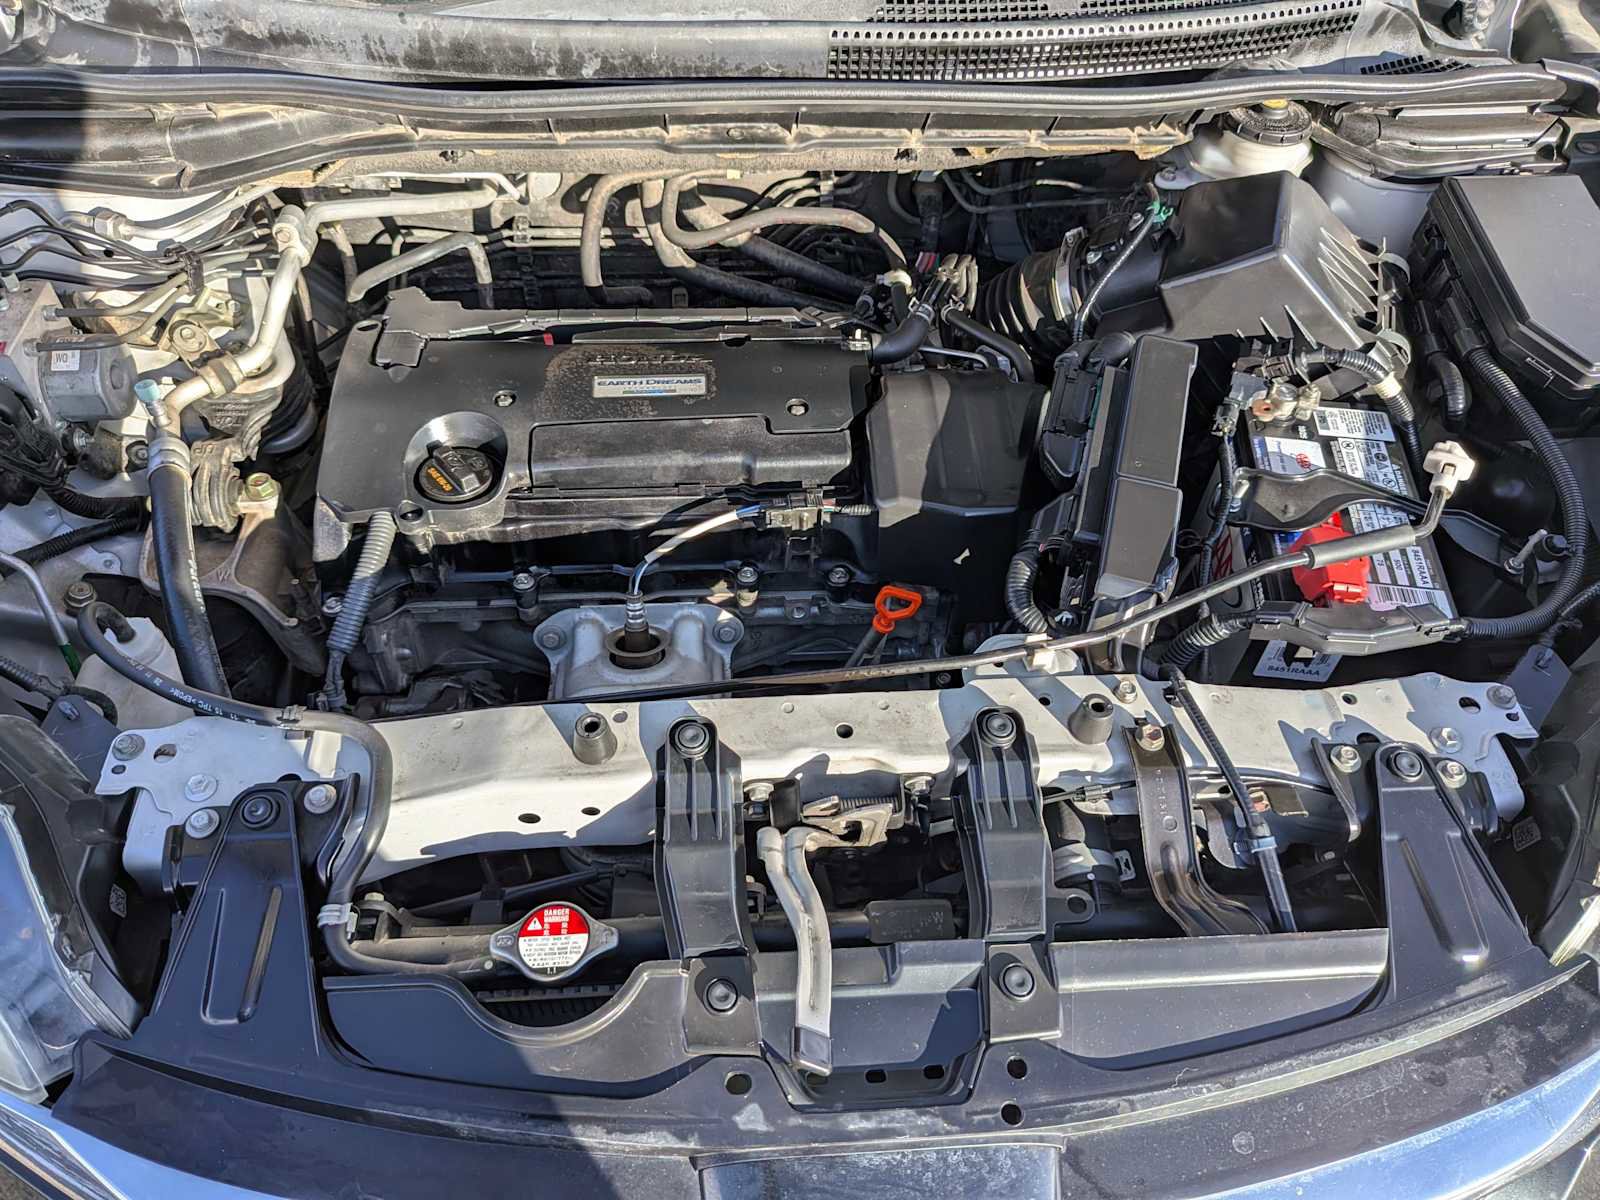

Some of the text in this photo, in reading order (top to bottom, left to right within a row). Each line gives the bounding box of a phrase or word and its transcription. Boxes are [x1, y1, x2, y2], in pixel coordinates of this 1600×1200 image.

[596, 378, 703, 387] EARTH DREAMS
[544, 908, 570, 917] DANGER
